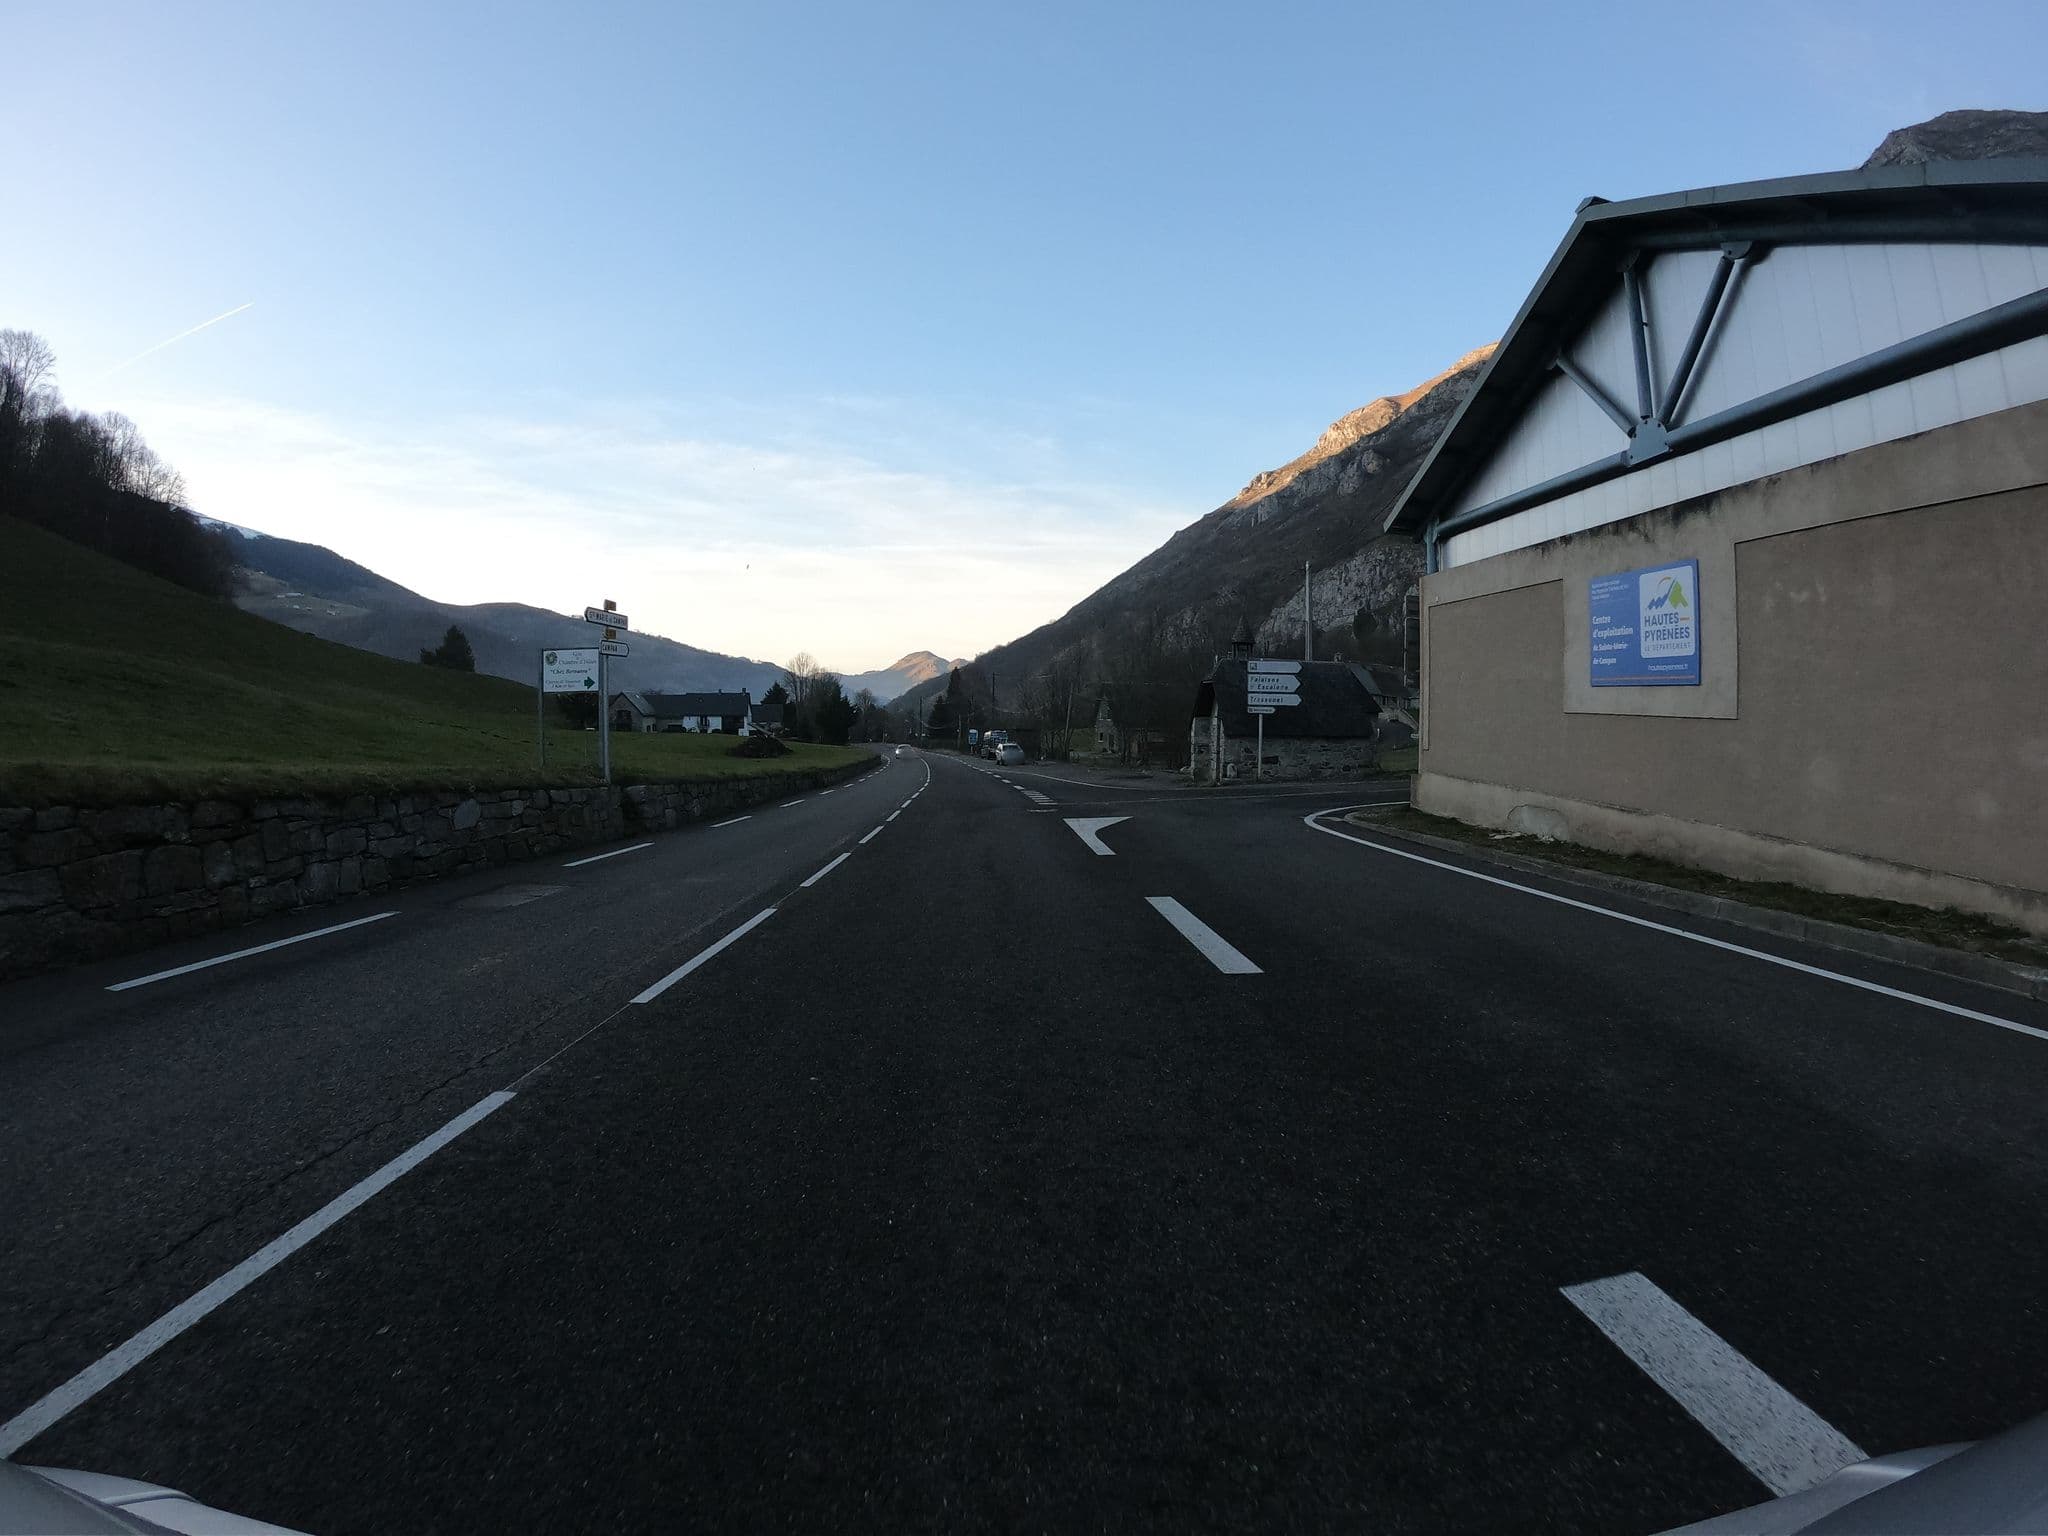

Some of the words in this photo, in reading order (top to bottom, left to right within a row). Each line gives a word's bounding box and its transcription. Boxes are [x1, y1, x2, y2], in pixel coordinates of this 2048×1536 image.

[1592, 616, 1611, 624] Centre
[1644, 612, 1680, 627] HAUTES
[1592, 626, 1634, 640] d'exploitation
[1644, 625, 1690, 642] PYRÉNÉES
